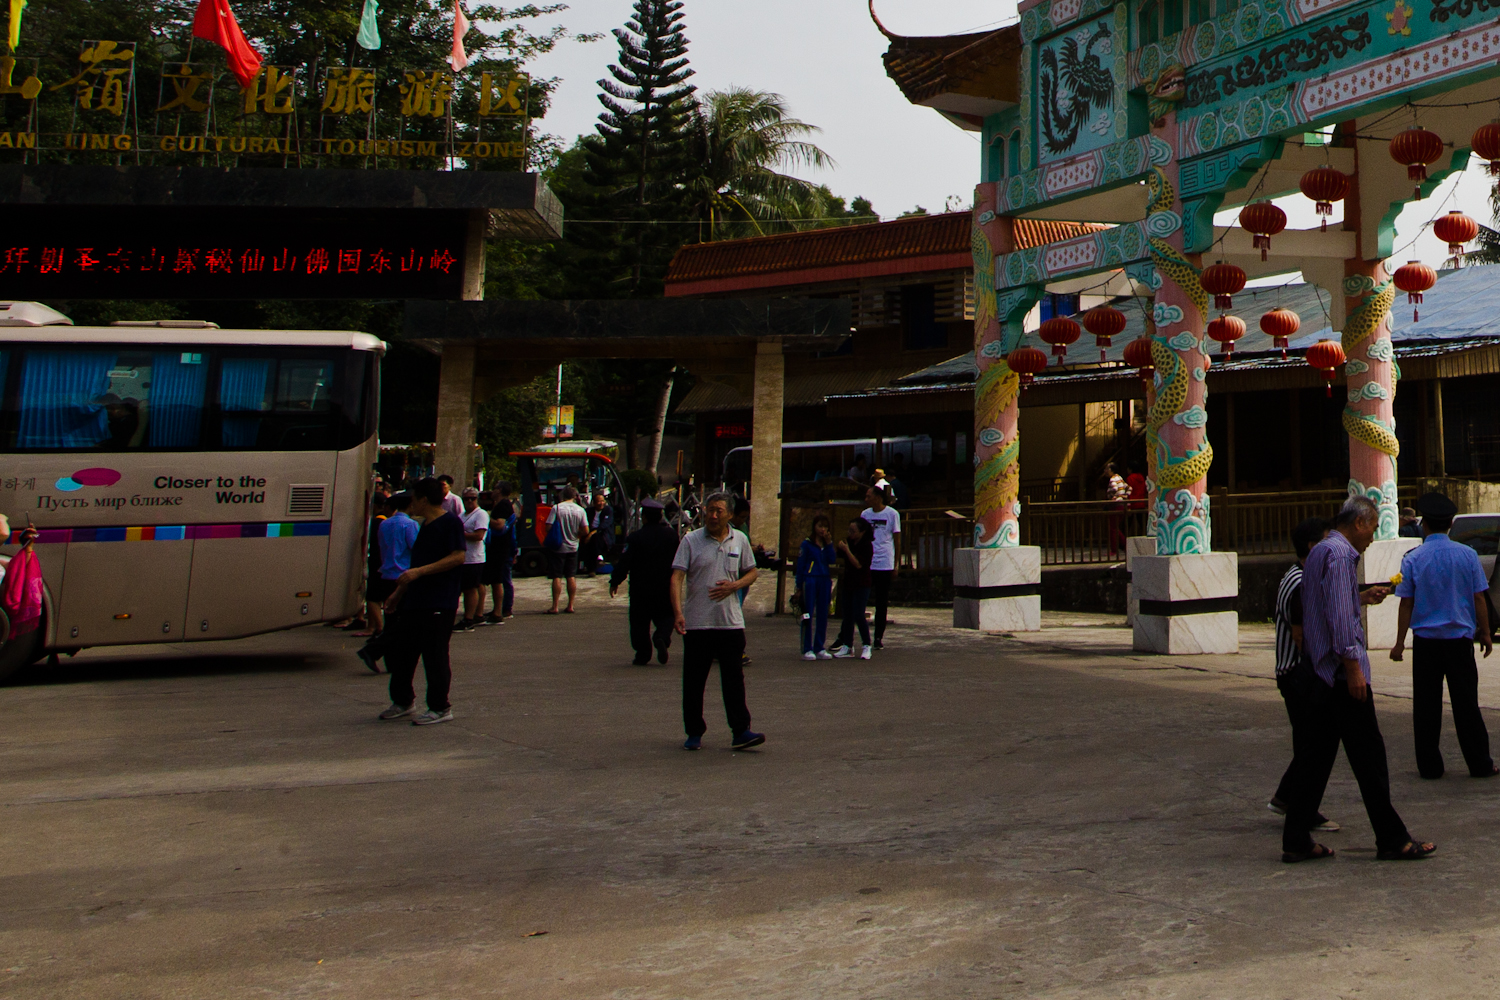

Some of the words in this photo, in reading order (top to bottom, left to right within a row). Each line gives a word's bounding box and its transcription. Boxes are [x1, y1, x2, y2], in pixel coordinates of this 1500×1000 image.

[65, 133, 132, 150] LING
[160, 135, 297, 154] CULTURAL
[322, 138, 437, 158] TOURISM
[459, 141, 526, 159] ZONE
[0, 477, 36, 491] 하게
[154, 476, 212, 489] Closer
[216, 476, 234, 488] to
[239, 475, 267, 488] the
[37, 495, 89, 512] Пусть
[94, 497, 127, 510] мир
[130, 494, 183, 506] ближе
[215, 491, 265, 504] World
